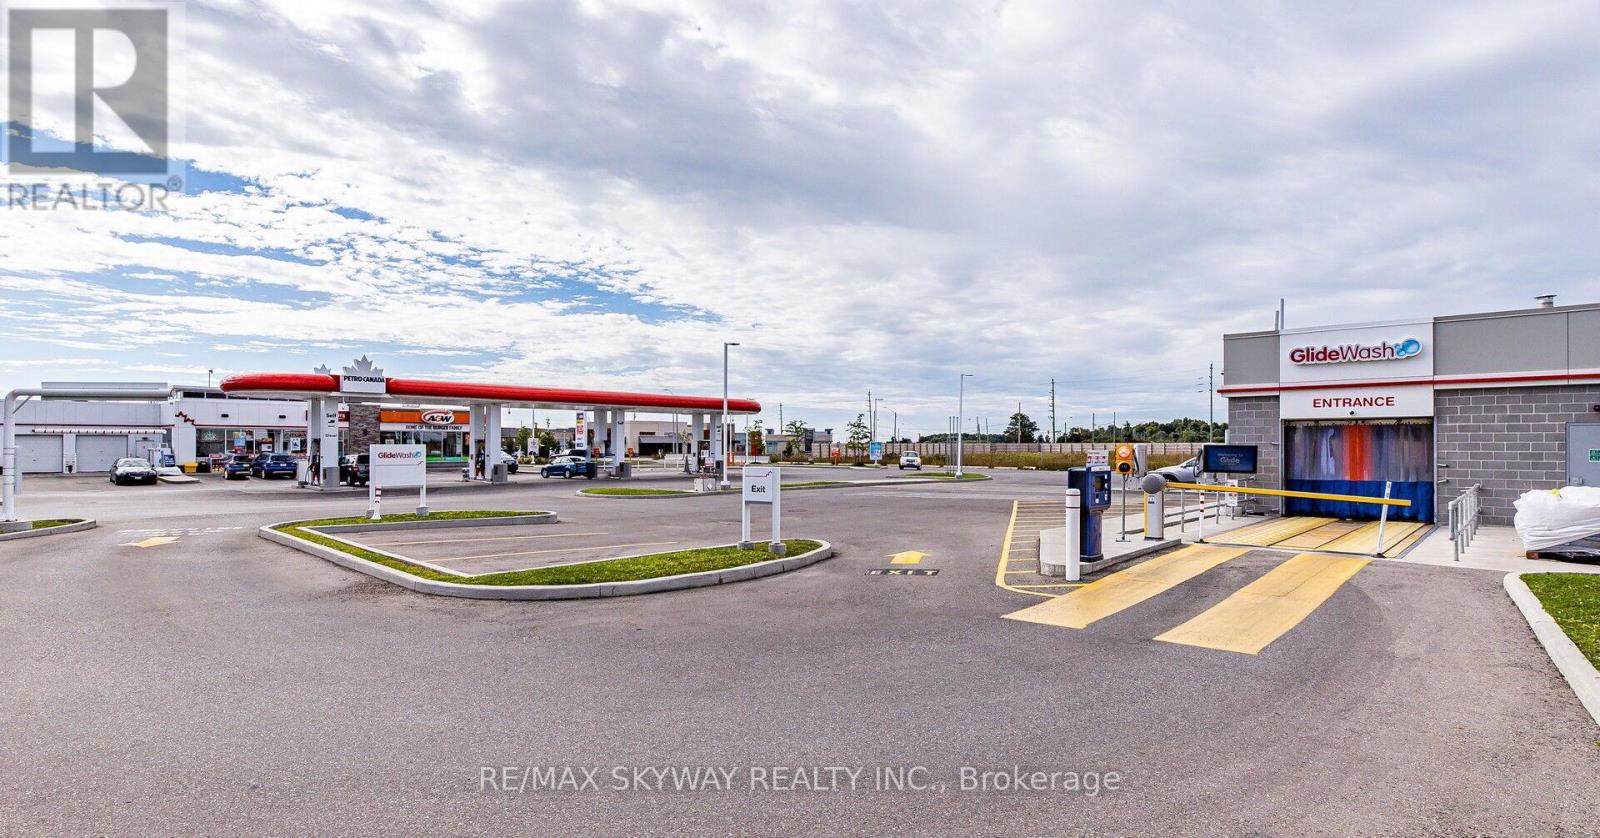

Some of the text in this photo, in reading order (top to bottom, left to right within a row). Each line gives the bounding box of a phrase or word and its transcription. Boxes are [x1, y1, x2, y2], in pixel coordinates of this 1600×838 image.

[1290, 342, 1395, 363] GlideWash
[1312, 396, 1395, 408] ENTRANCE
[378, 451, 414, 459] GlideWash
[751, 484, 771, 493] Exit
